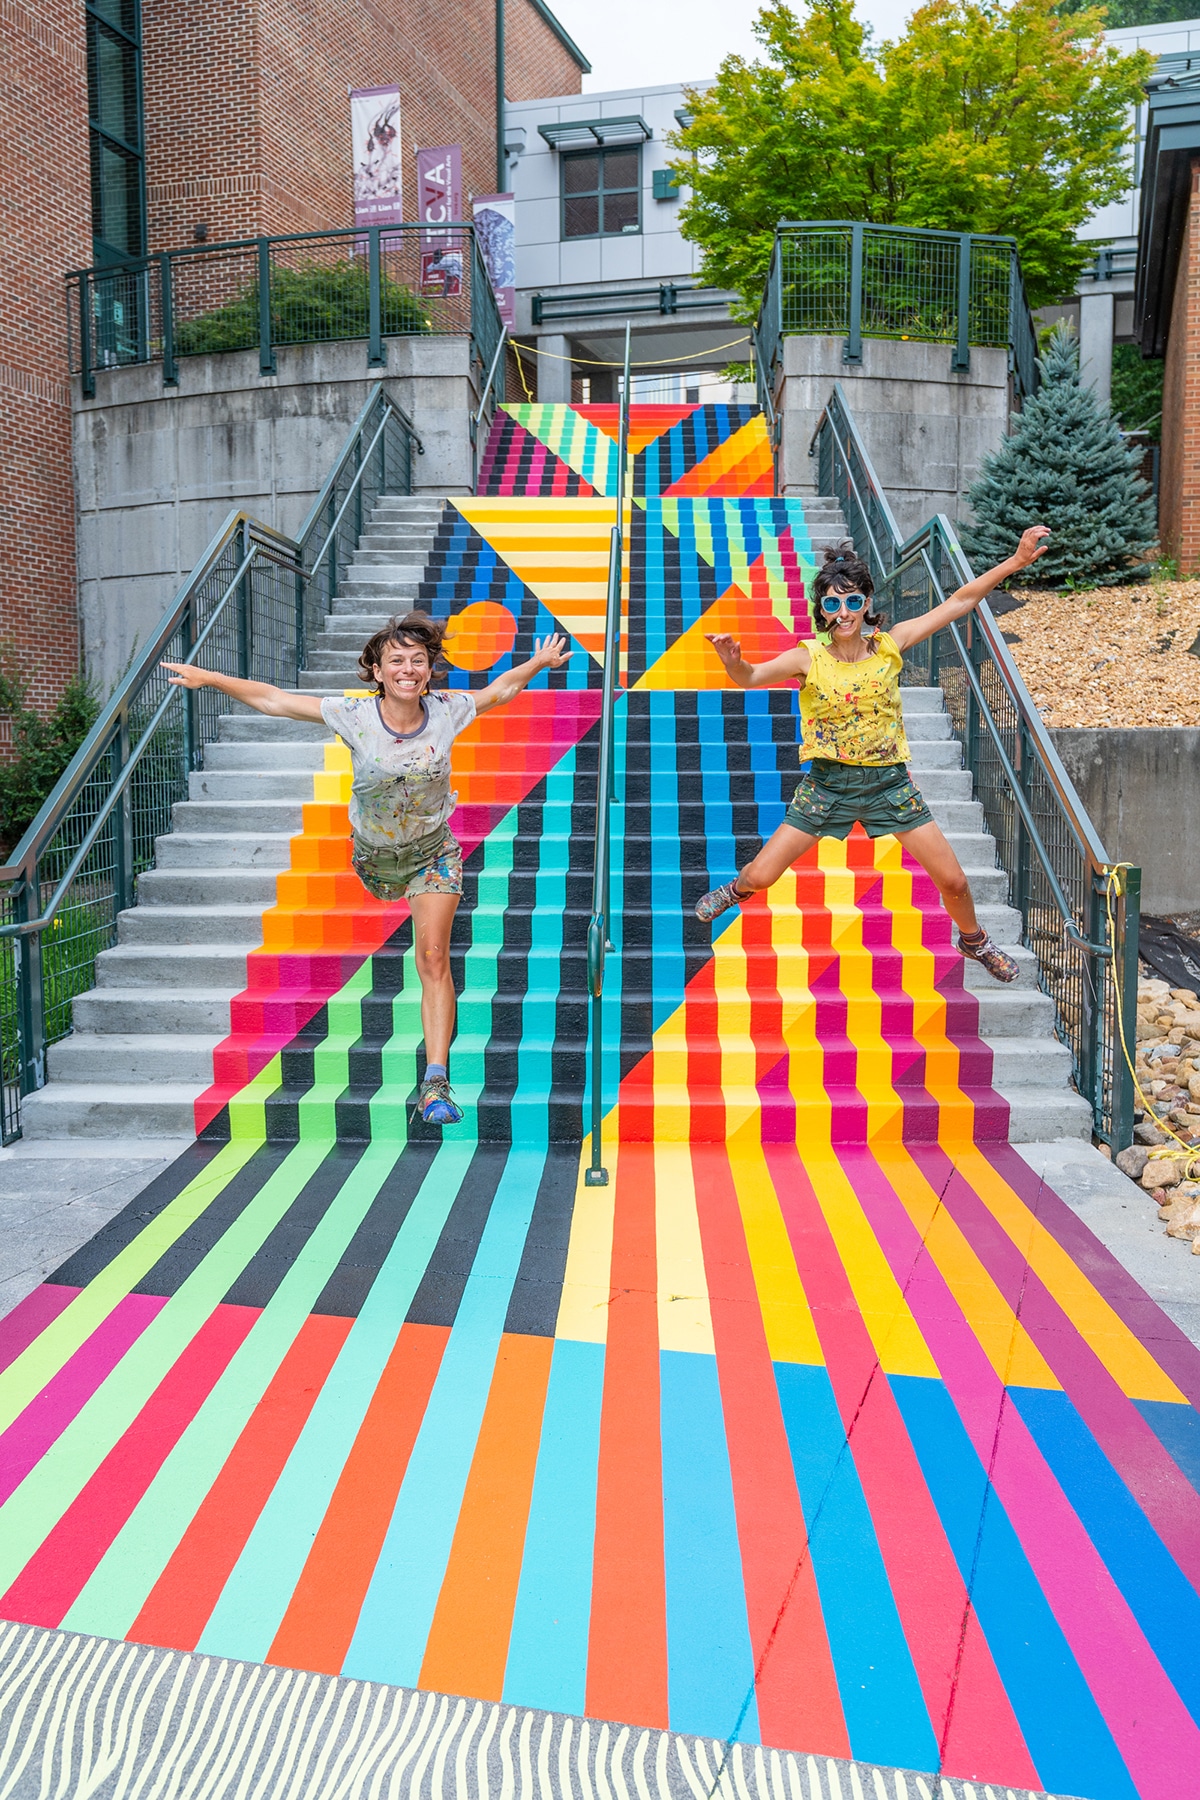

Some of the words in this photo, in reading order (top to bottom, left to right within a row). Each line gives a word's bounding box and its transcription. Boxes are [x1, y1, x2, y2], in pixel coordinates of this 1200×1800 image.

[355, 206, 369, 214] Lian
[378, 204, 392, 212] Lian
[424, 163, 446, 243] TCVA
